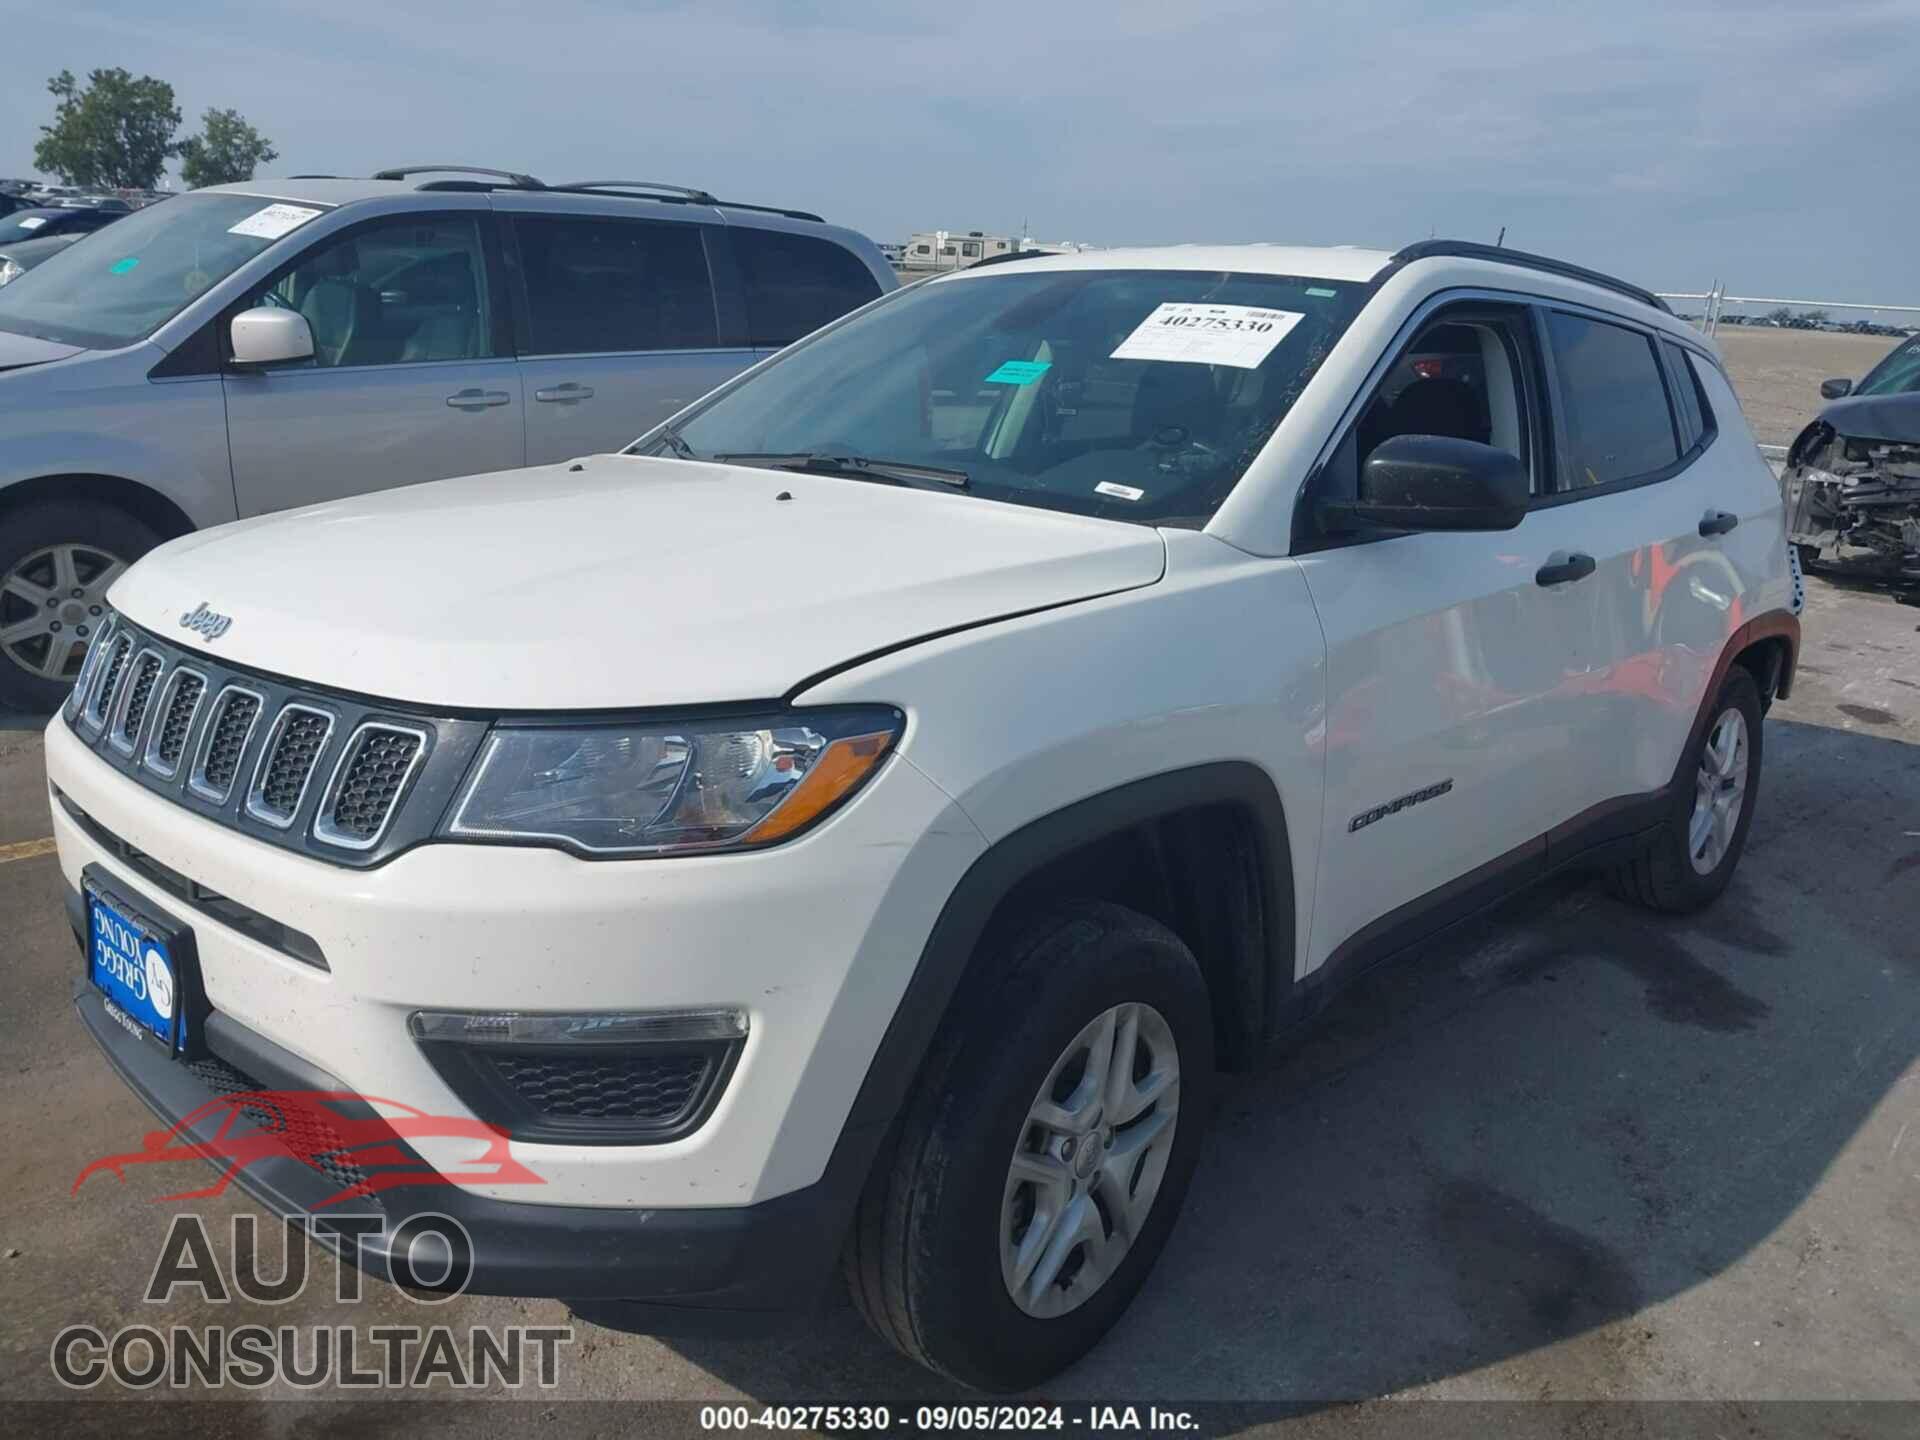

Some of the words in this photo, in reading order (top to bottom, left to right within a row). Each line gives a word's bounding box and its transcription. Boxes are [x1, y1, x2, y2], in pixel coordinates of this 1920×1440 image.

[1159, 315, 1274, 332] 40275330
[179, 601, 232, 642] Jeep
[95, 907, 145, 970] YOUNG
[97, 938, 147, 1001] GREGG
